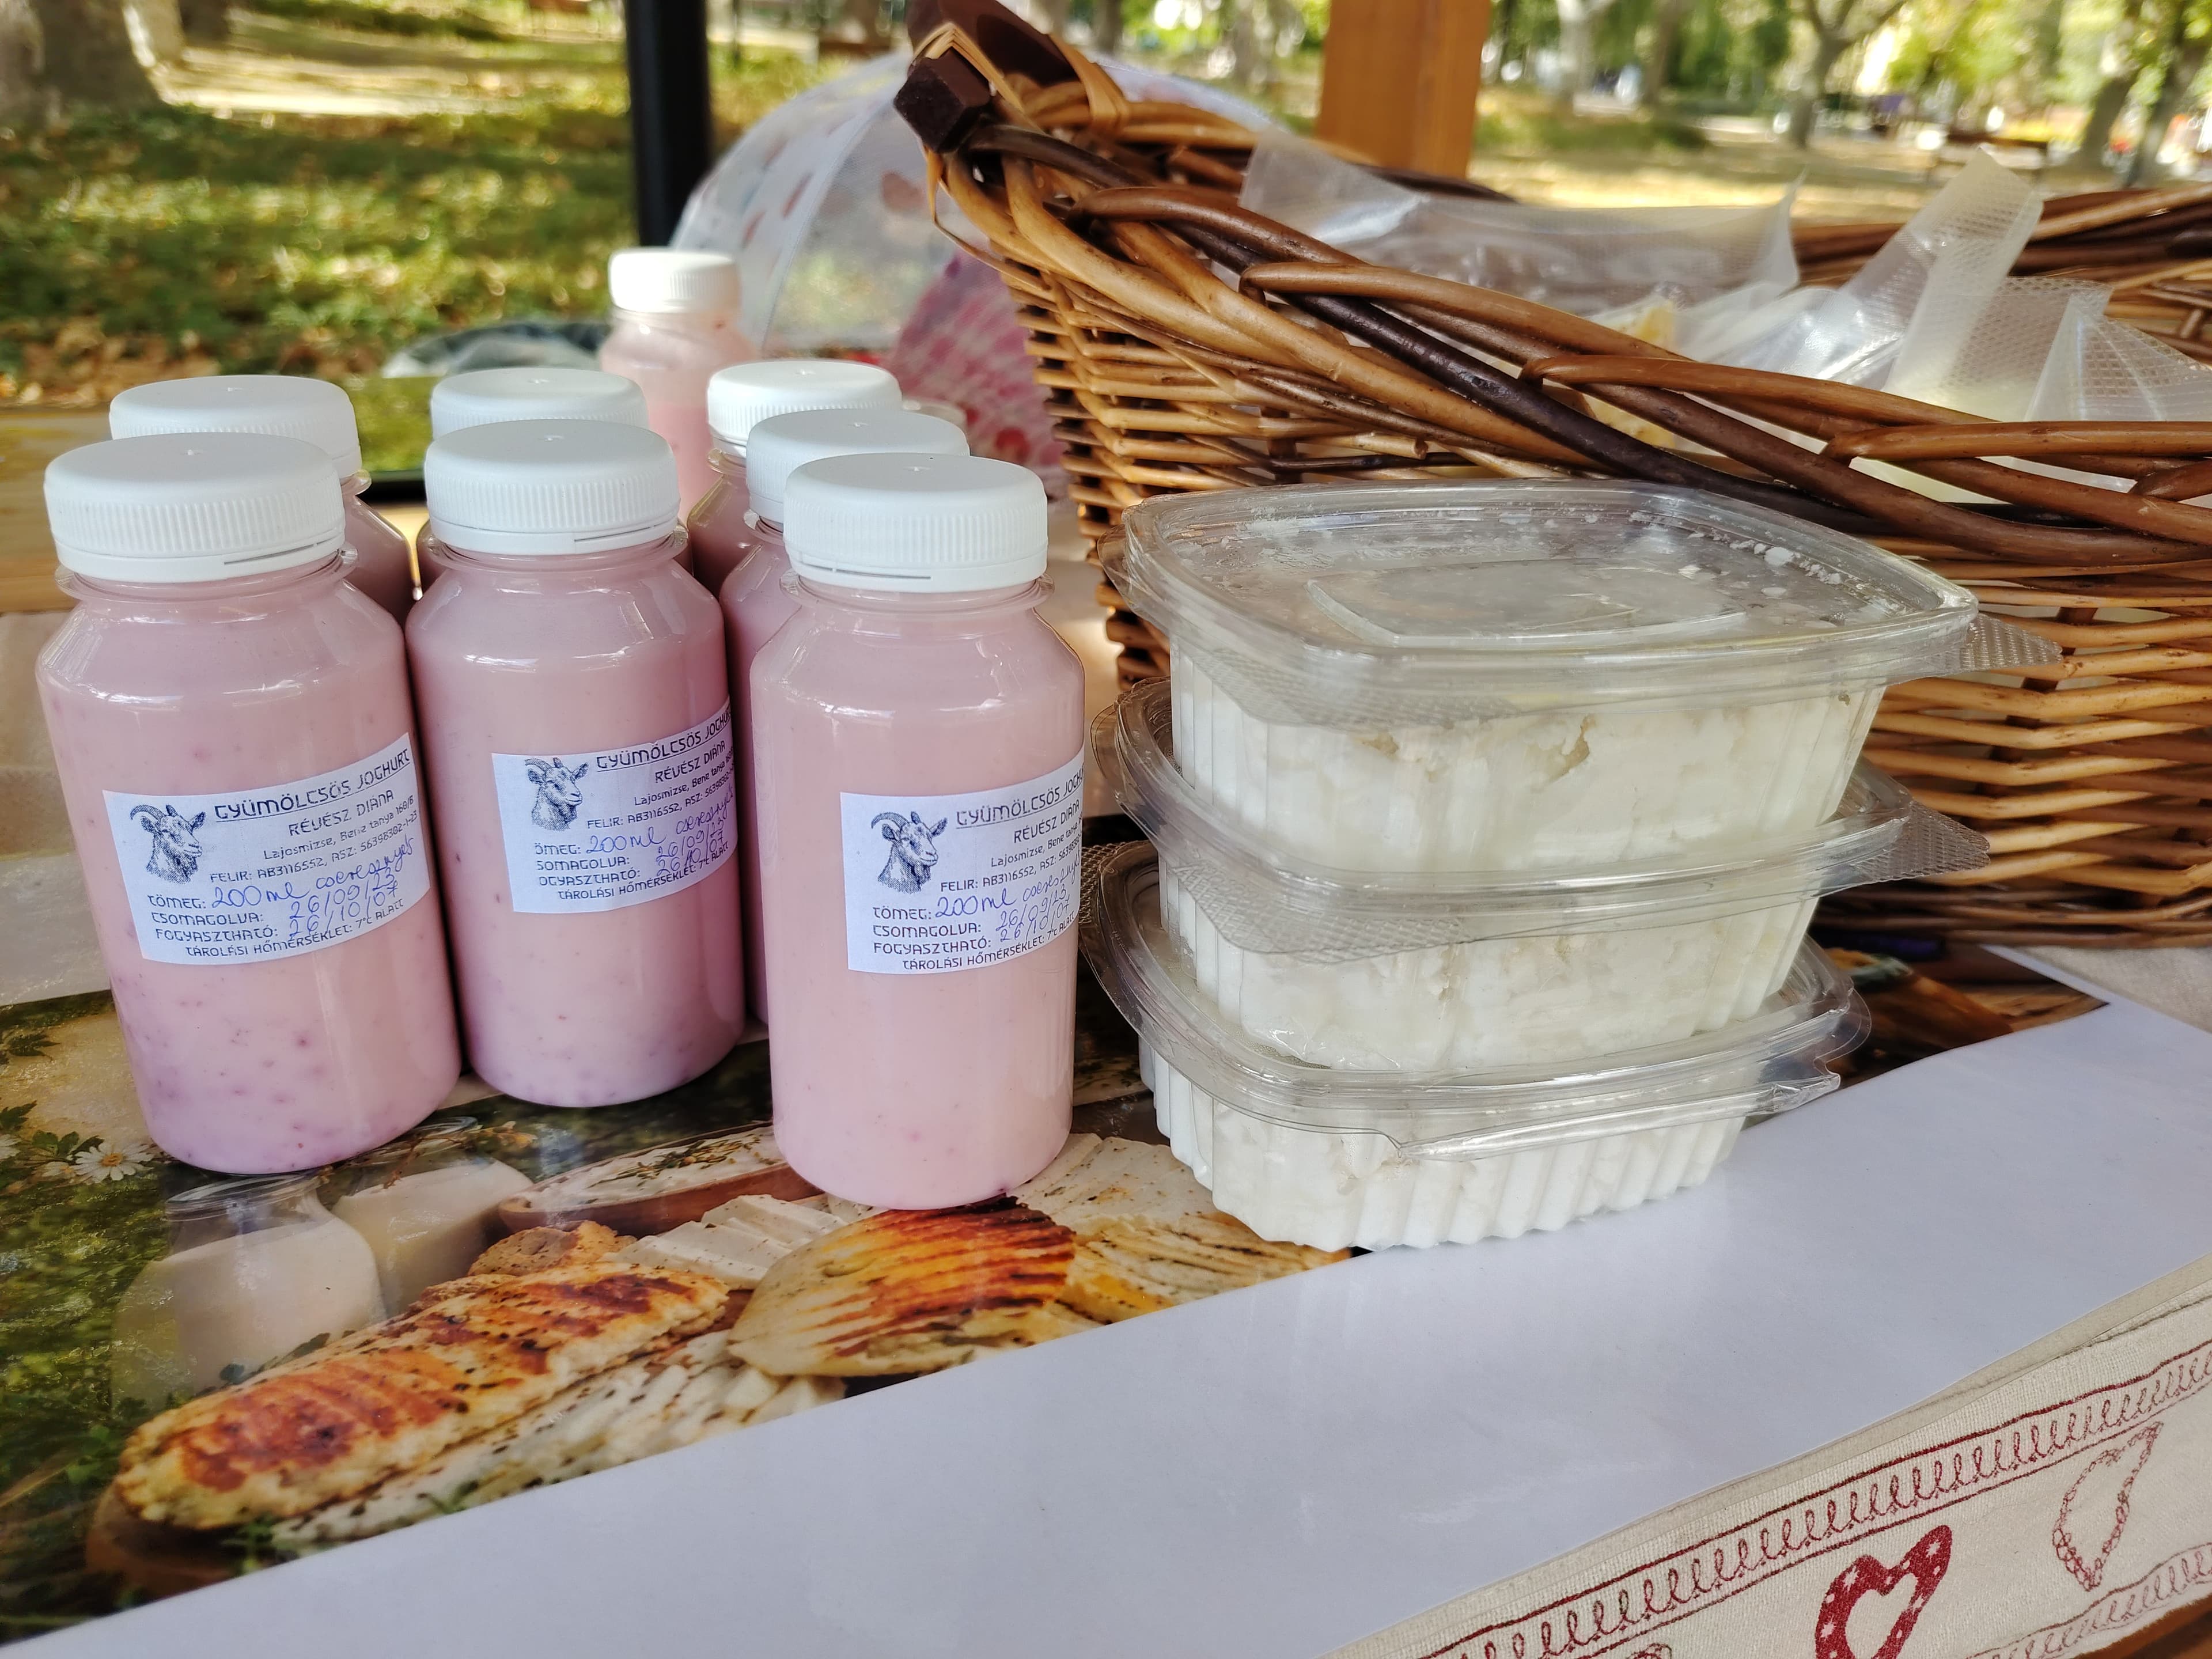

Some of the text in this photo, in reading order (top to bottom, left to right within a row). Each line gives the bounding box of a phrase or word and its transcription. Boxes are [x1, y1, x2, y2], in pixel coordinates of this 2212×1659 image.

[597, 731, 701, 768] GYÜMÖLCSÖS
[705, 704, 731, 739] JOGHUR
[655, 757, 700, 783] RÉVÉSZ
[704, 740, 725, 764] DIÁNA
[214, 749, 410, 819] GYÜMÖLCSÖS JOGHURT
[634, 784, 689, 805] Lajosmizse,
[692, 772, 710, 787] Bene
[289, 790, 394, 836] RÉVÉSZ DIÁNA
[588, 818, 623, 829] FELIR:
[628, 802, 682, 823] AB3116552,
[685, 793, 703, 806] ASZ:
[957, 786, 1060, 825] GYÜMÖLCSÖS
[1014, 816, 1057, 843] RÉVÉSZ
[1060, 799, 1080, 824] DIÁNA
[263, 837, 336, 859] Lajosmizse,
[340, 825, 366, 841] Bene
[370, 813, 394, 828] tanya
[991, 822, 1078, 867] Lajosmizse, Bene tanya
[210, 871, 252, 882] FELIR:
[258, 858, 327, 879] AB3116552,
[332, 847, 357, 862] ASZ:
[558, 887, 614, 900] TÁROLÁSI
[619, 865, 696, 894] HŐMÉRSÉKLET:
[711, 841, 728, 861] ALATT
[941, 880, 978, 892] FELIR:
[983, 866, 1037, 887] AB3116552,
[1040, 855, 1056, 870] ASZ:
[147, 894, 206, 909] TÖMEG:
[151, 912, 263, 924] CSOMAGOLVA:
[873, 905, 931, 920] TÖMEG:
[156, 927, 278, 941] FOGYASZTHATÓ:
[187, 944, 248, 957] TÁROLÁSI
[253, 924, 353, 955] HŐMÉRSÉKLET:
[376, 899, 403, 920] ALATT
[873, 923, 981, 937] CSOMAGOLVA:
[874, 936, 991, 955] FOGYASZTHATÓ:
[903, 957, 962, 969] TÁROLÁSI
[967, 934, 1044, 965] HŐMÉRSÉKLET:
[1059, 910, 1074, 933] ALATT
